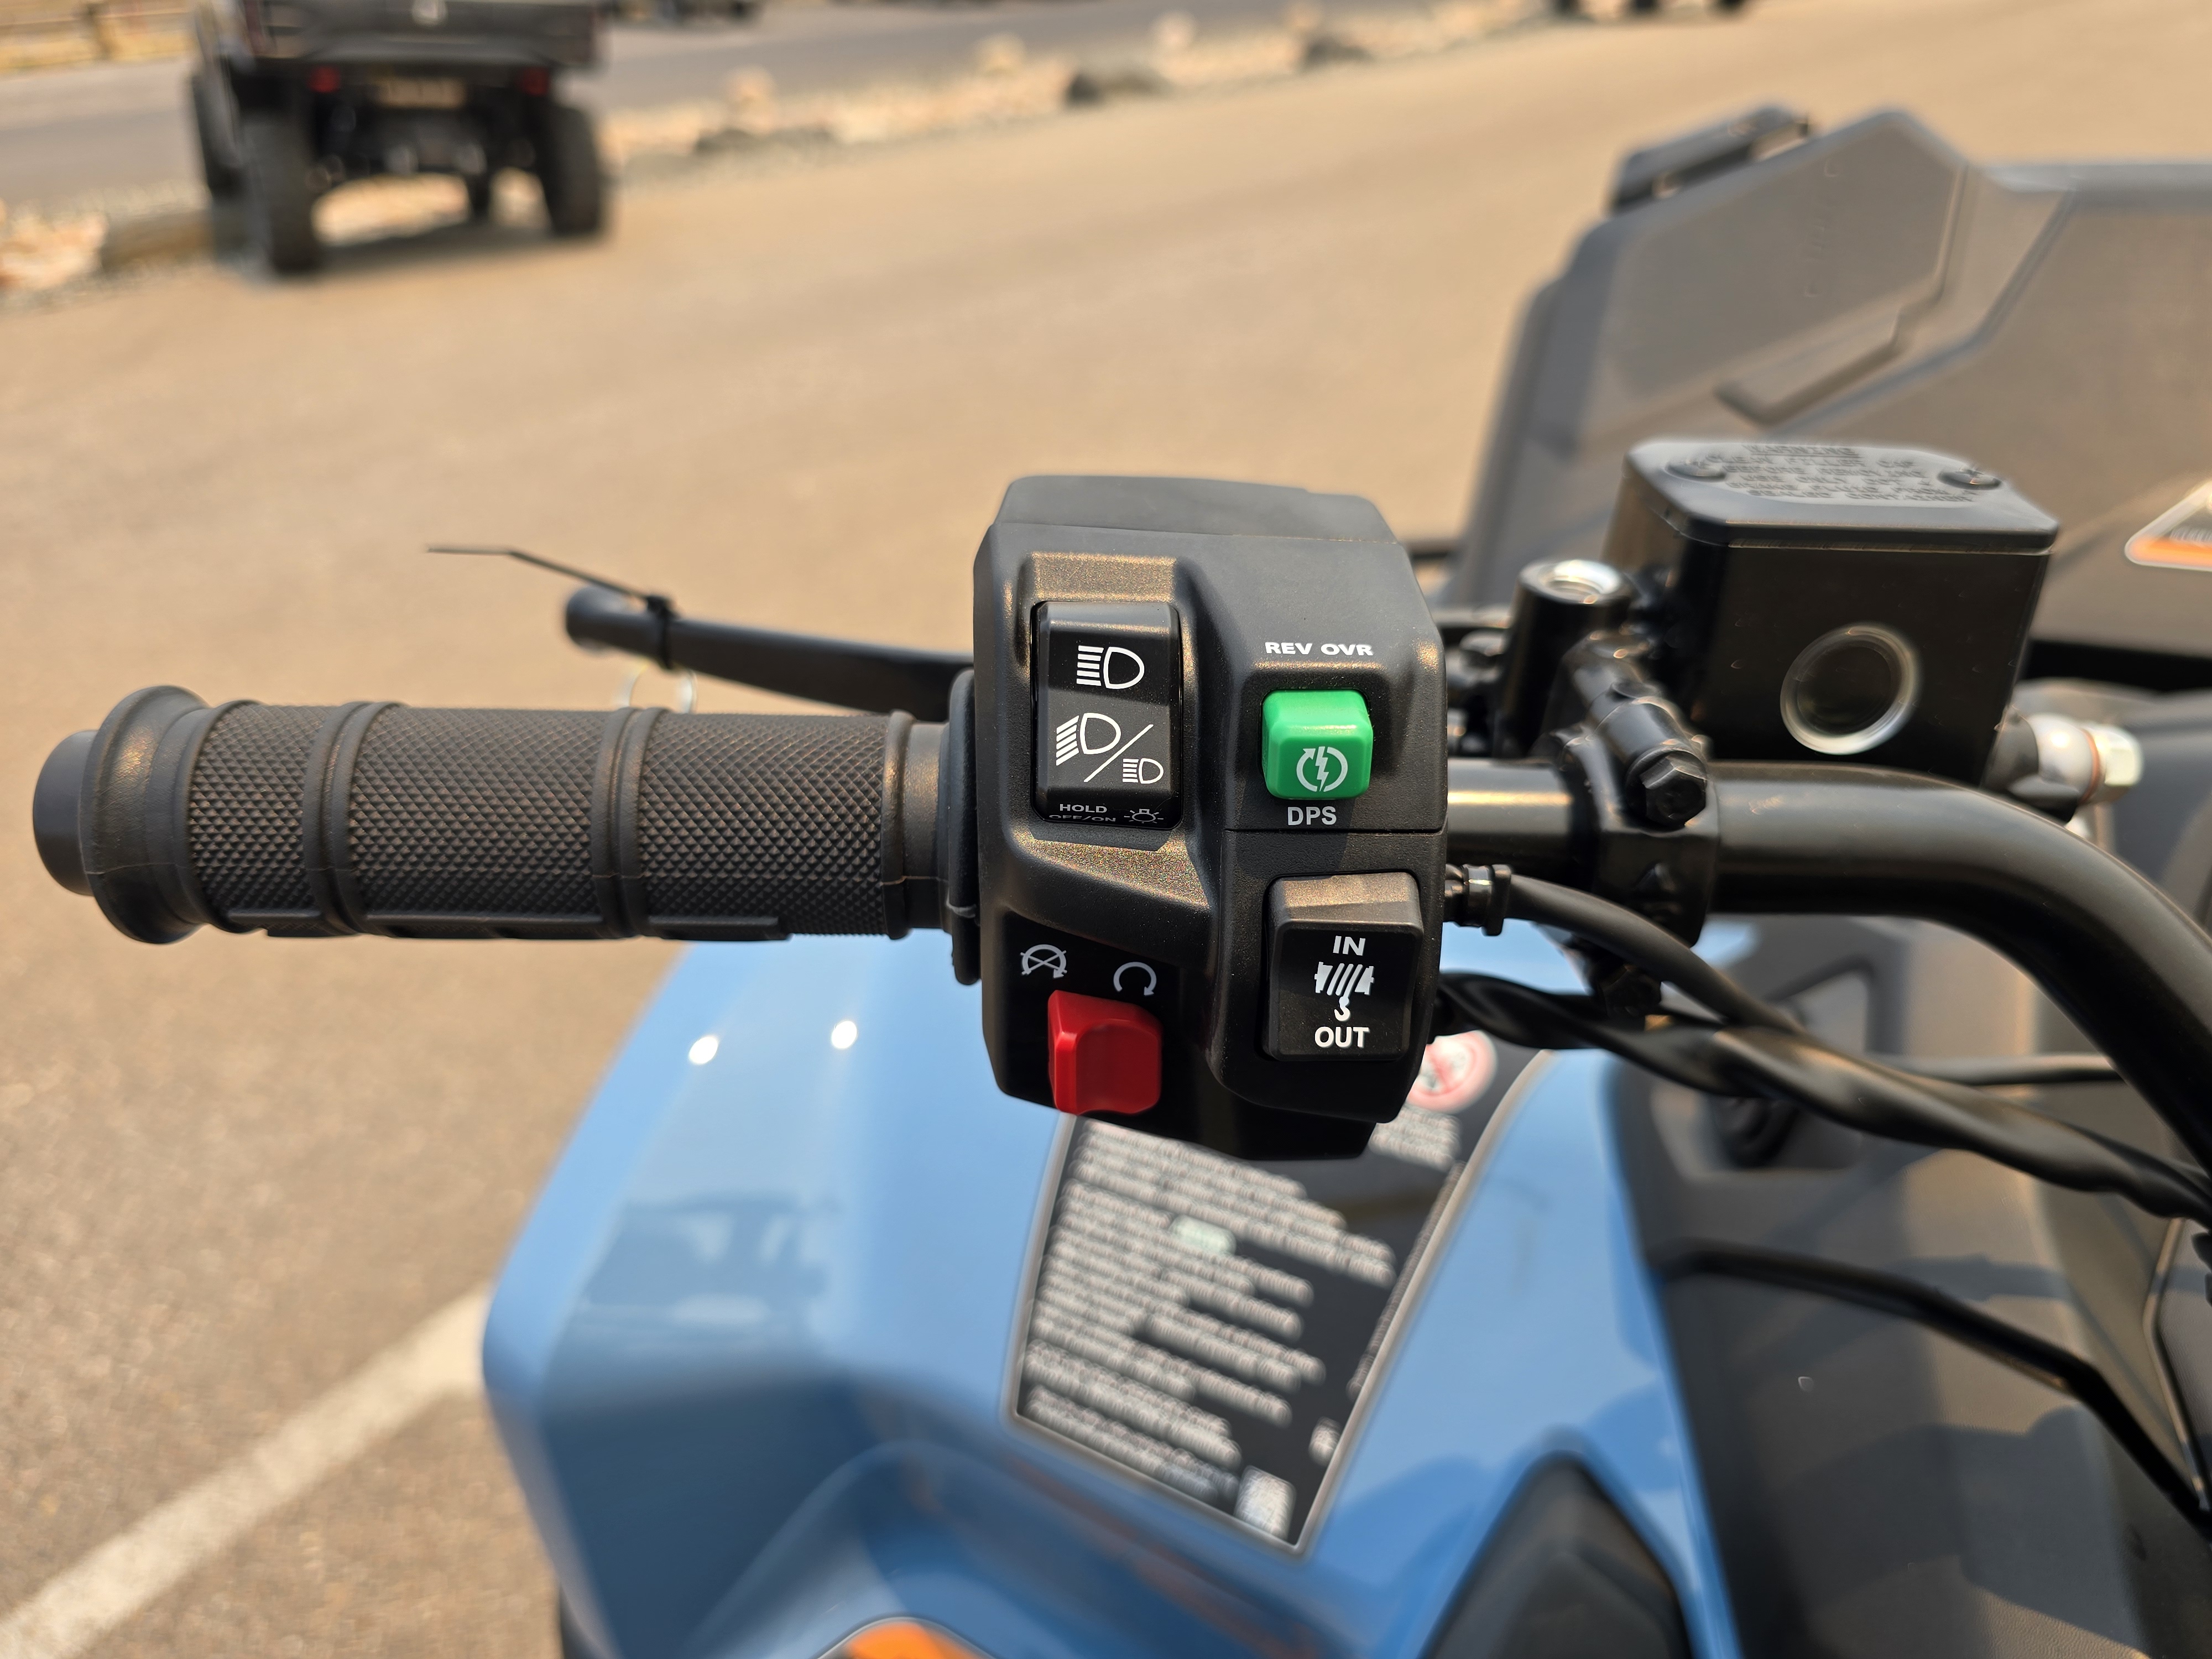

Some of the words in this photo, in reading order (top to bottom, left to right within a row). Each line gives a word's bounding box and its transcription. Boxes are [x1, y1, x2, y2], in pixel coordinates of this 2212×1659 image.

[1265, 642, 1313, 655] REV
[1321, 644, 1374, 656] OVR
[1060, 804, 1108, 813] HOLD
[1287, 806, 1337, 826] DPS
[1333, 936, 1366, 956] IN
[1314, 1026, 1370, 1048] OUT
